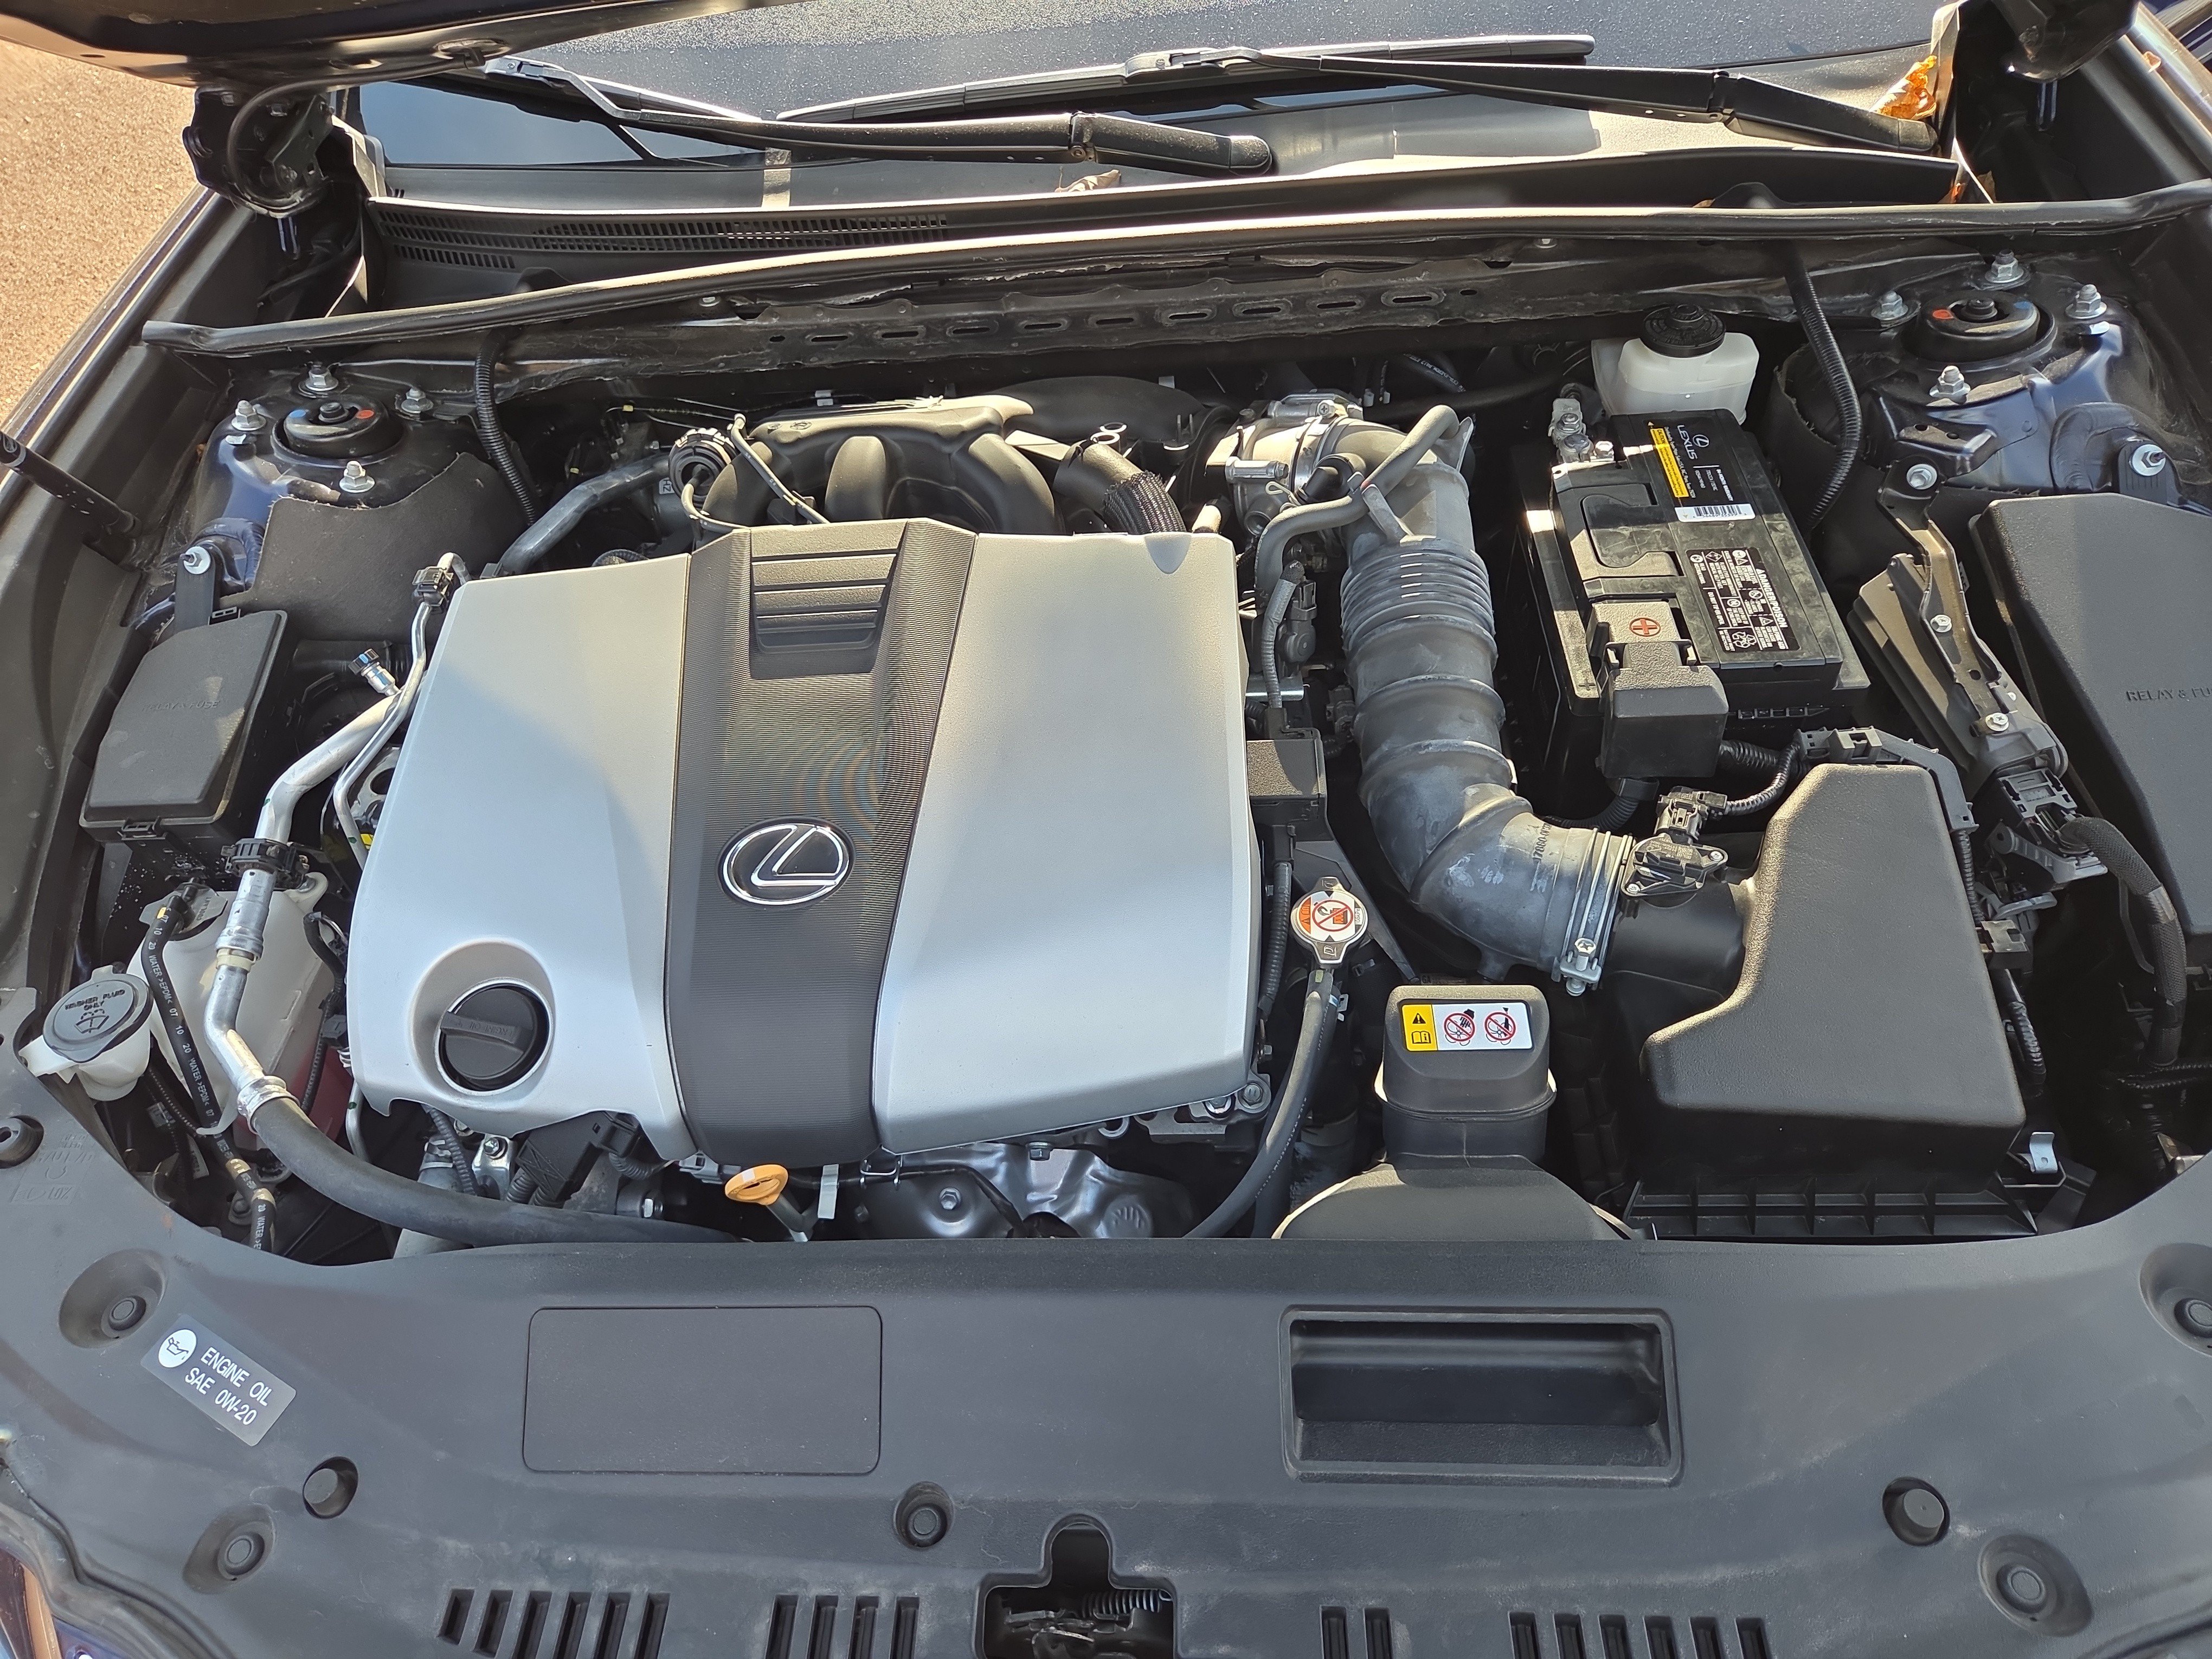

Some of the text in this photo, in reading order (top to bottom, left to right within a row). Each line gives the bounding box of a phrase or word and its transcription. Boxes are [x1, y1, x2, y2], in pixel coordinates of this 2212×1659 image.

[1677, 425, 1697, 460] LEXUS
[1759, 573, 1789, 628] DANGER/POISON
[2126, 689, 2173, 701] RELAY
[2191, 687, 2212, 698] FU
[190, 701, 220, 709] FUSE
[149, 941, 157, 950] 20
[149, 955, 163, 978] WATER
[83, 1000, 105, 1011] ONLY
[169, 1008, 178, 1017] 07
[175, 1025, 184, 1035] 10
[183, 1043, 191, 1053] 20
[189, 1057, 202, 1082] WATER
[255, 1216, 266, 1238] WATER
[201, 1347, 272, 1407] ENGINE OIL
[185, 1367, 258, 1425] SAE 0W-20
